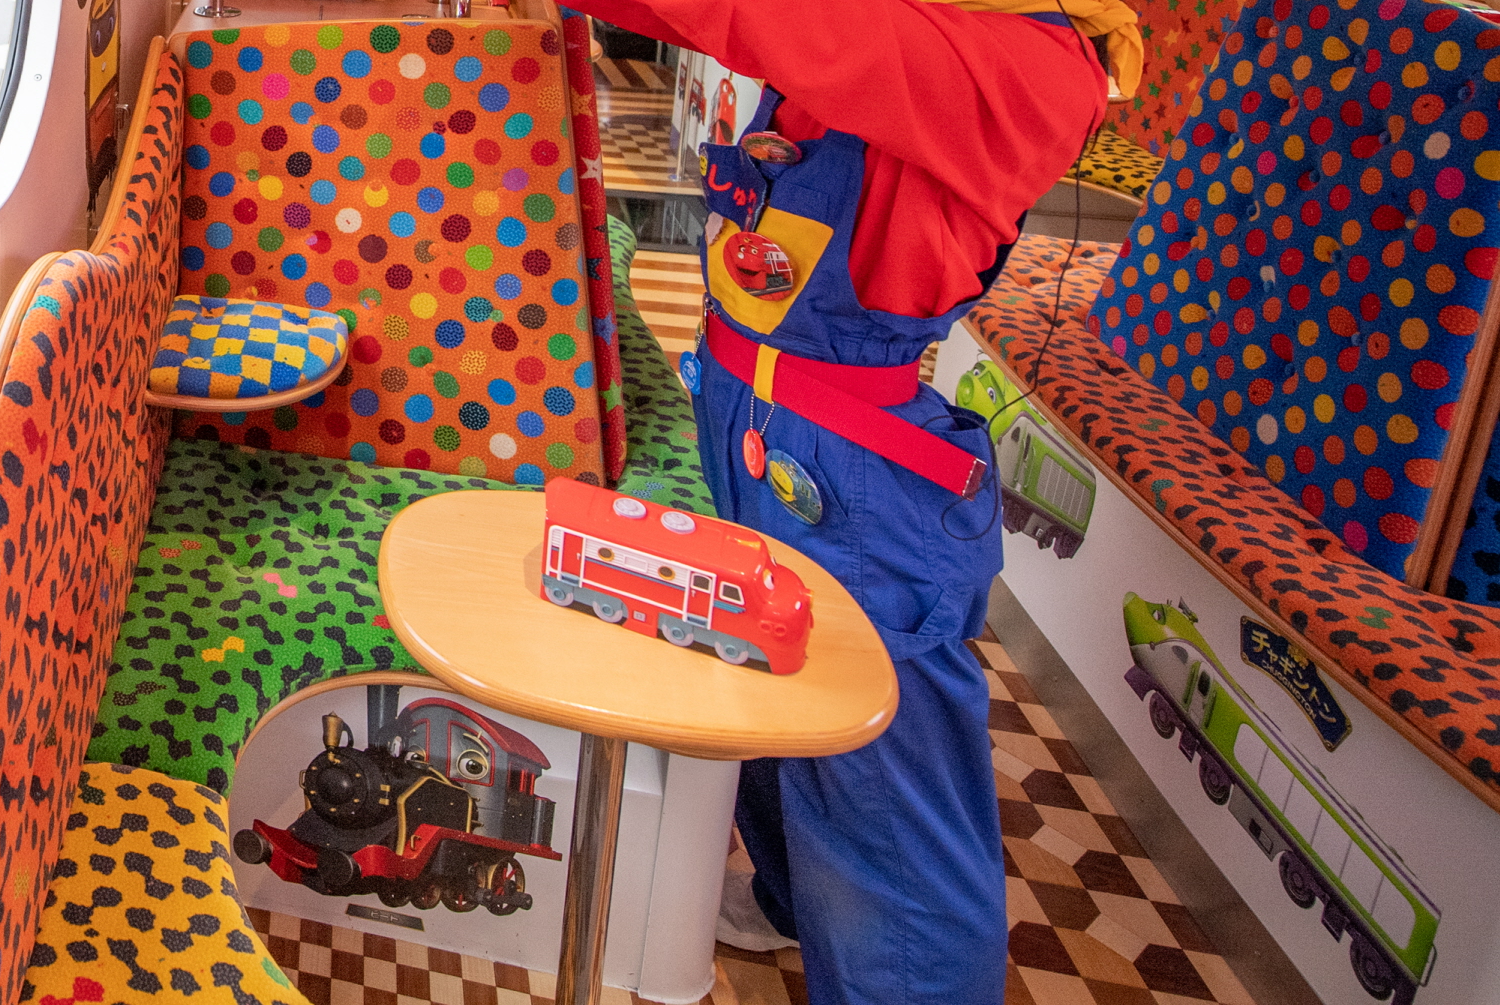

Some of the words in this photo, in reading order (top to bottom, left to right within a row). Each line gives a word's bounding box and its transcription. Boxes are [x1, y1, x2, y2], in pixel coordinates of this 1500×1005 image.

[1250, 629, 1337, 724] チャギントン
[1261, 659, 1318, 721] CHUGGINGTON
